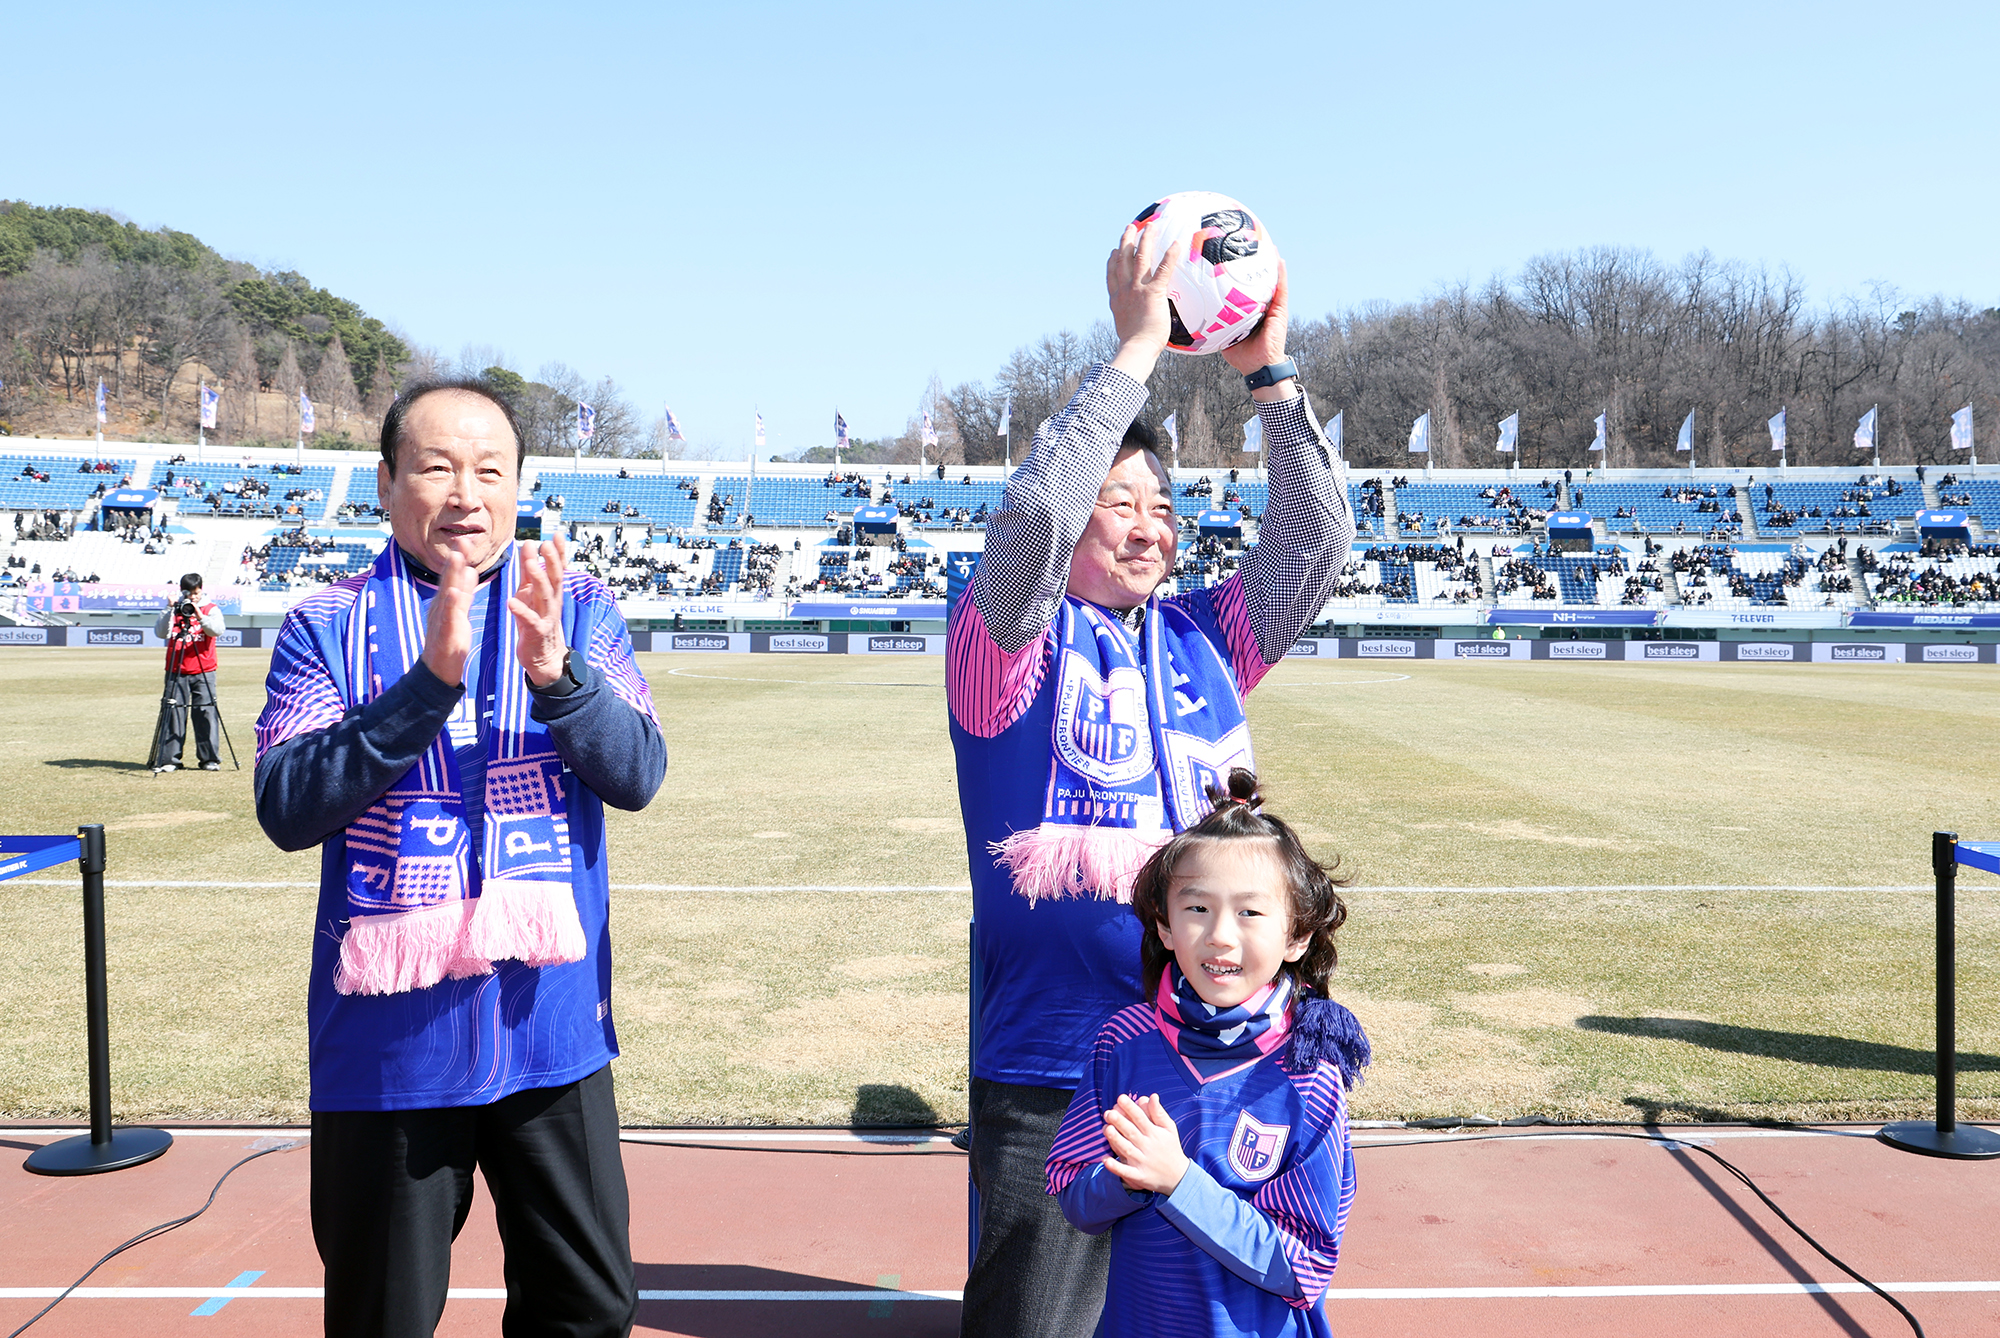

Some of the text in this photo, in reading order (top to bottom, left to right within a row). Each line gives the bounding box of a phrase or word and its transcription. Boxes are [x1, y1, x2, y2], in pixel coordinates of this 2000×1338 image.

[680, 605, 724, 613] KELME
[1552, 612, 1576, 621] NH
[1913, 615, 1973, 624] MEDALIST
[0, 631, 44, 641] est sleep
[89, 631, 141, 642] best sleep
[216, 633, 238, 643] leep
[674, 637, 726, 648] best sleep
[773, 638, 824, 649] best sleep
[871, 639, 923, 649] best sleep
[1361, 643, 1411, 653] best sleep
[1457, 644, 1508, 656] best sleep
[1553, 645, 1603, 656] best sleep
[1647, 646, 1697, 657] best sleep
[1741, 647, 1790, 657] best sleep
[1834, 648, 1883, 658] best sleep
[1927, 648, 1975, 659] best sleep
[1087, 694, 1105, 721] P
[1058, 684, 1091, 770] PAJU FRONTIER
[1117, 727, 1134, 755] F
[1057, 788, 1086, 799] PAJU
[1089, 790, 1140, 803] FRONTIER
[1245, 1131, 1257, 1146] P
[1254, 1152, 1267, 1168] F
